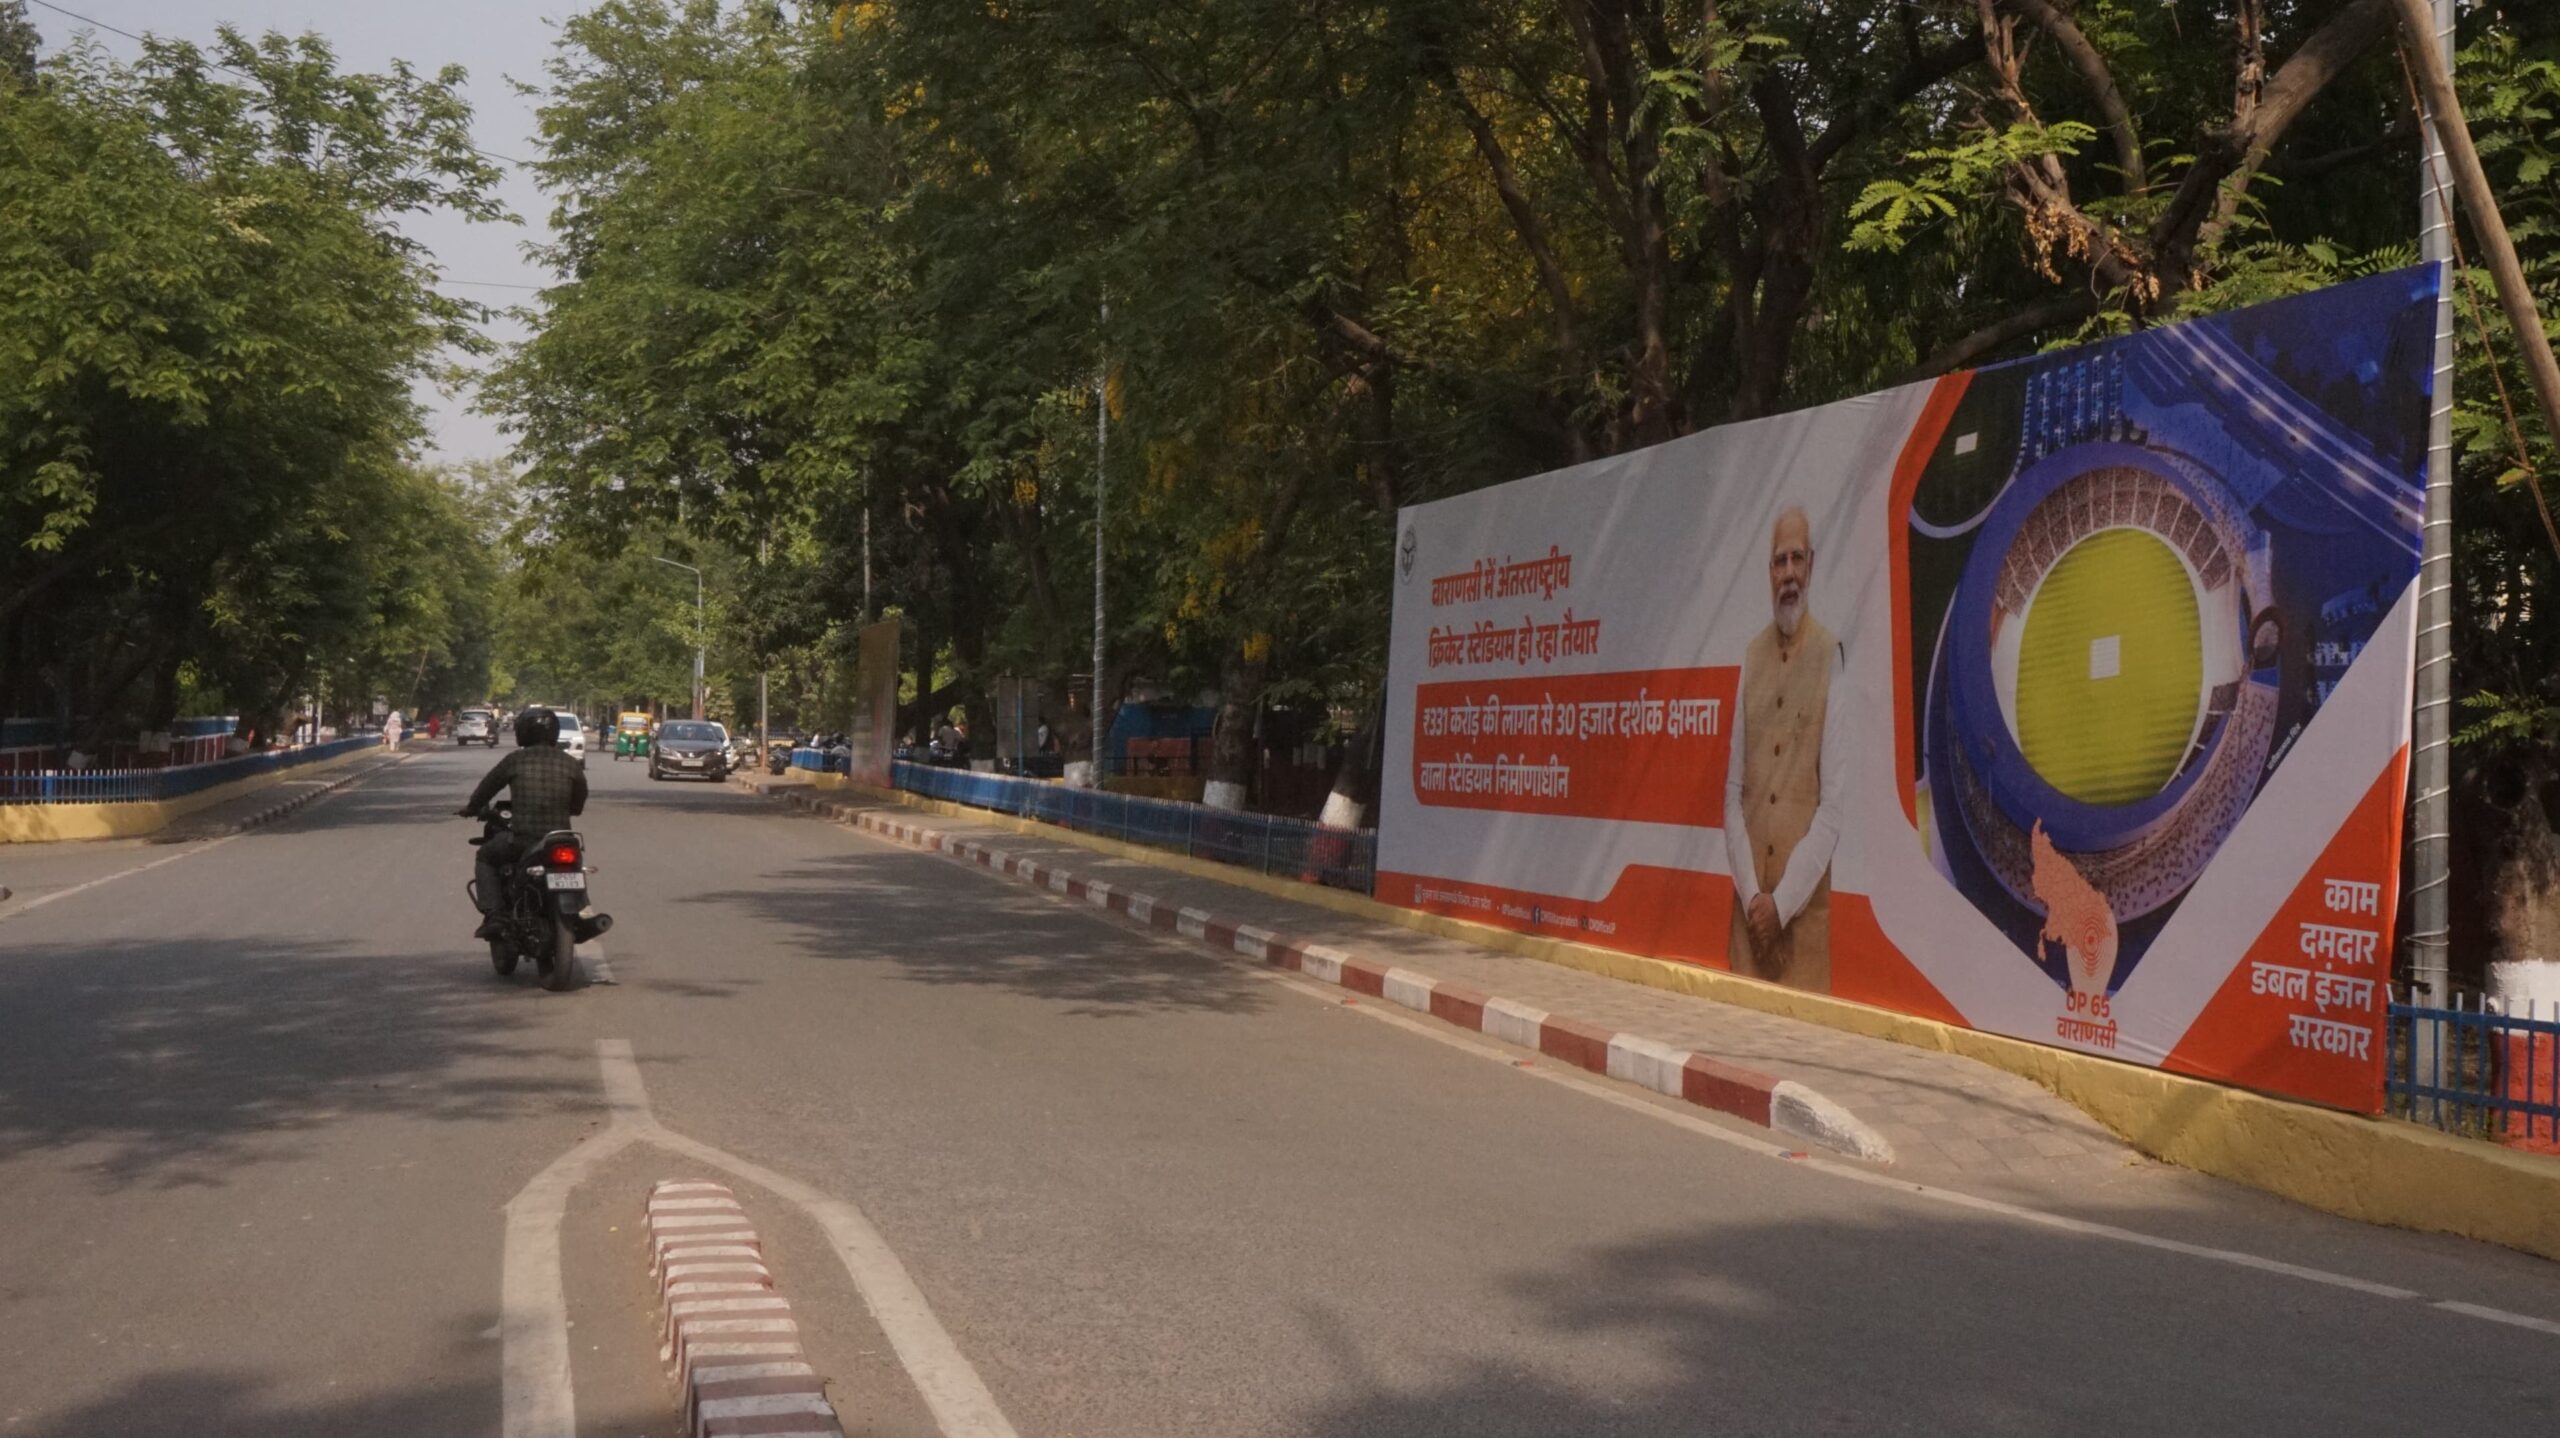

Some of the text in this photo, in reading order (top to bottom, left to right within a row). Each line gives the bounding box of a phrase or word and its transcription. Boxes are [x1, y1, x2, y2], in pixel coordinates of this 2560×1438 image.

[1432, 545, 1571, 606] वाराणसी में अंतरराष्ट्रीय
[1429, 607, 1600, 668] क्रिकेट स्टेडियम हो रहा तैयार
[1450, 696, 1481, 744] करोड़
[1482, 694, 1500, 735] की
[1501, 704, 1539, 735] लागत
[1541, 692, 1554, 735] से
[1556, 703, 1575, 735] 30
[1579, 702, 1617, 740] हजार
[1619, 688, 1664, 738] दर्शक
[1667, 699, 1721, 738] क्षमता
[1421, 753, 1570, 798] वाला स्टेडियम निर्माणाधीन
[2324, 878, 2380, 915] काम
[2300, 922, 2379, 964] दमदार
[2091, 994, 2110, 1018] 65
[2251, 961, 2375, 1013] डबल इंजन
[2057, 1016, 2117, 1049] वाराणसी
[2289, 1013, 2372, 1061] सरकार
